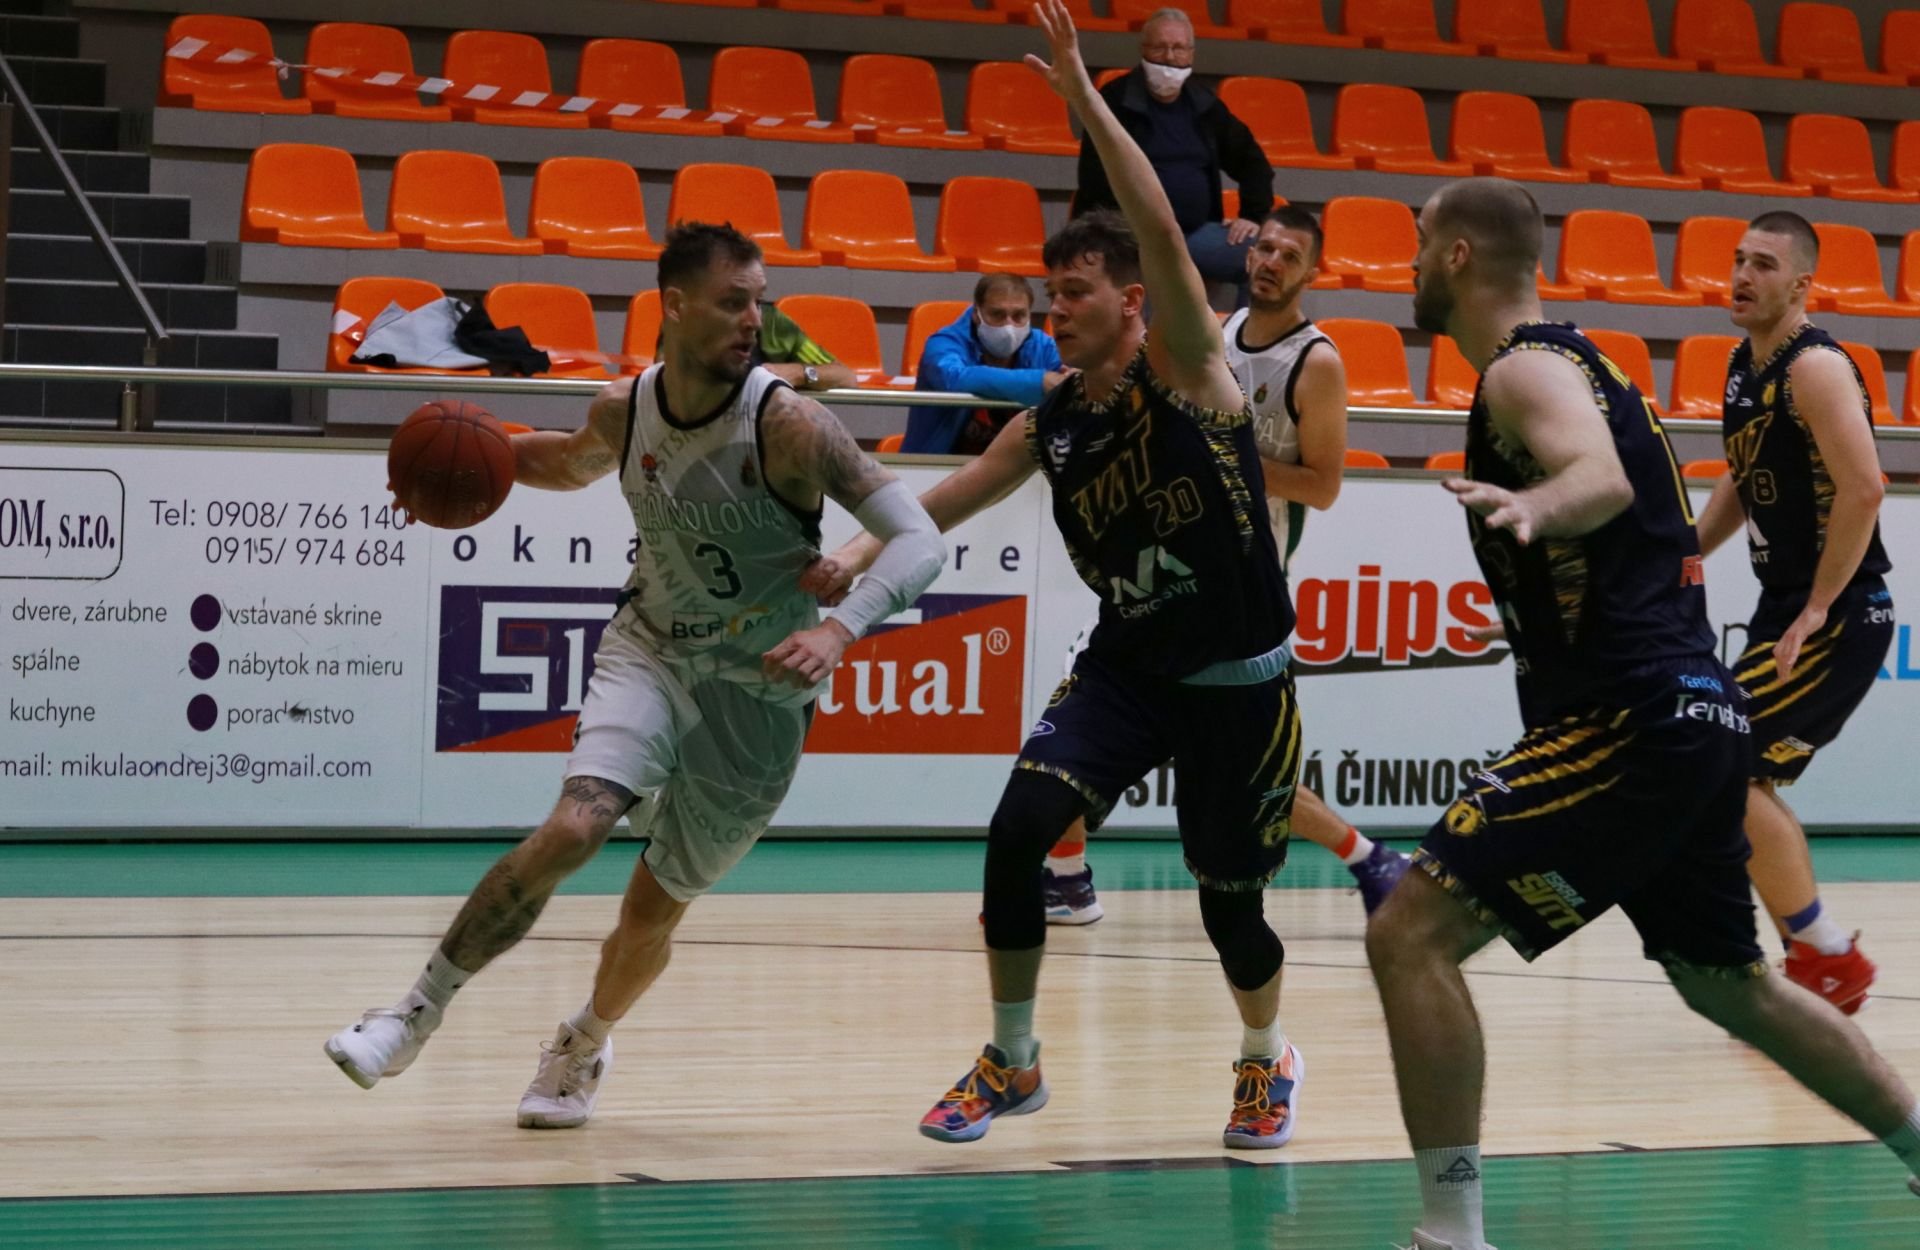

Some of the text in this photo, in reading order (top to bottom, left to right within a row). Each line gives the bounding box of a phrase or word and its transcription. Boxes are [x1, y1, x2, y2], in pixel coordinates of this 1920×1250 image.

[1751, 469, 1778, 505] 8
[149, 499, 409, 531] Tel: 0908/ 766 140
[1144, 475, 1204, 537] 20
[58, 512, 116, 549] s.r.o.
[205, 537, 406, 567] 0915/ 974 684
[695, 542, 744, 601] 3
[12, 597, 383, 626] dvere, zárubne vstávané skrine
[11, 647, 404, 682] spálne nábytok na mieru
[9, 697, 355, 731] kuchyne poradnstvo
[61, 753, 372, 784] mikulaondrej3@gmail.com
[1335, 749, 1503, 808] ČINNOS
[1436, 1170, 1481, 1184] PEAK
